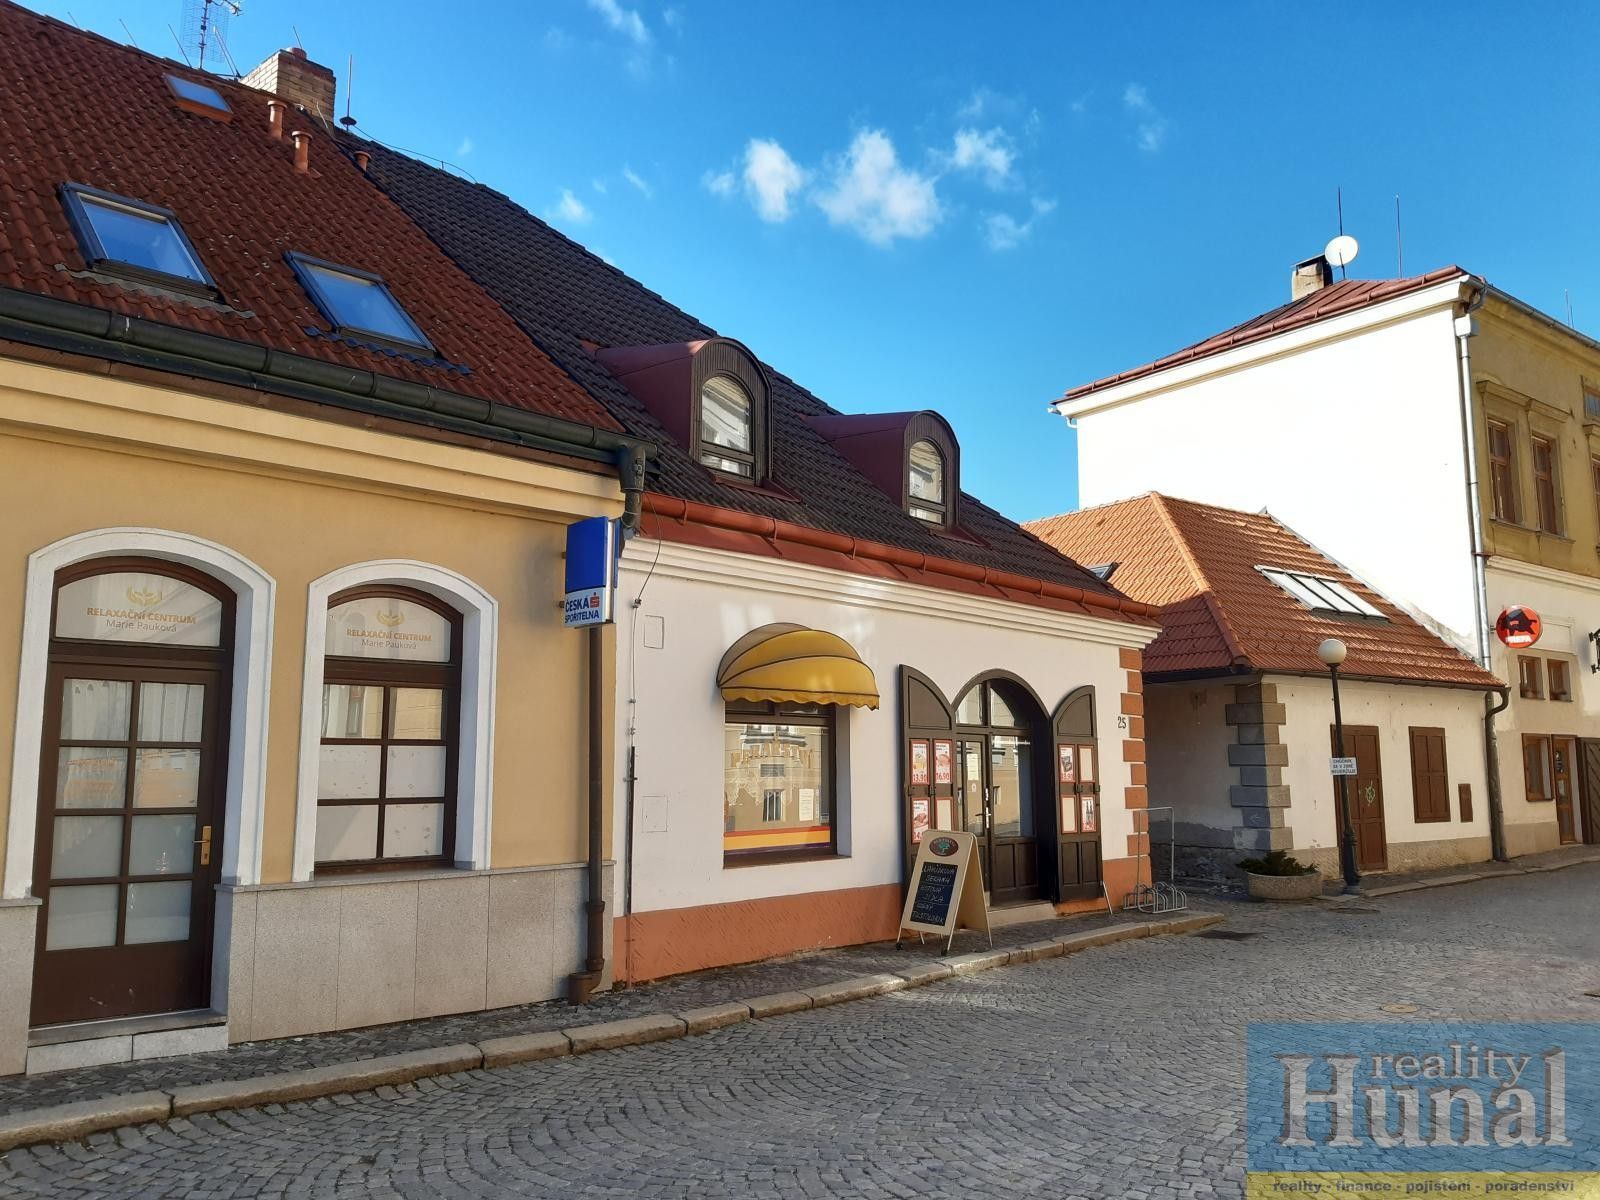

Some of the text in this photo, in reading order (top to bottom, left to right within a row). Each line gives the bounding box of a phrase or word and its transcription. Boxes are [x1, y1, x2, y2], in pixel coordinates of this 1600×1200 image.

[565, 596, 590, 612] ČESKÁ
[87, 607, 197, 624] RELAXAČNÍ CENTRUM
[565, 610, 599, 623] SPOŘITELNA
[106, 619, 177, 632] Marie Pauková
[346, 628, 432, 642] RELAXAČNÍ CENTRUM
[361, 639, 417, 649] Marie Pauková
[1118, 715, 1127, 728] 25
